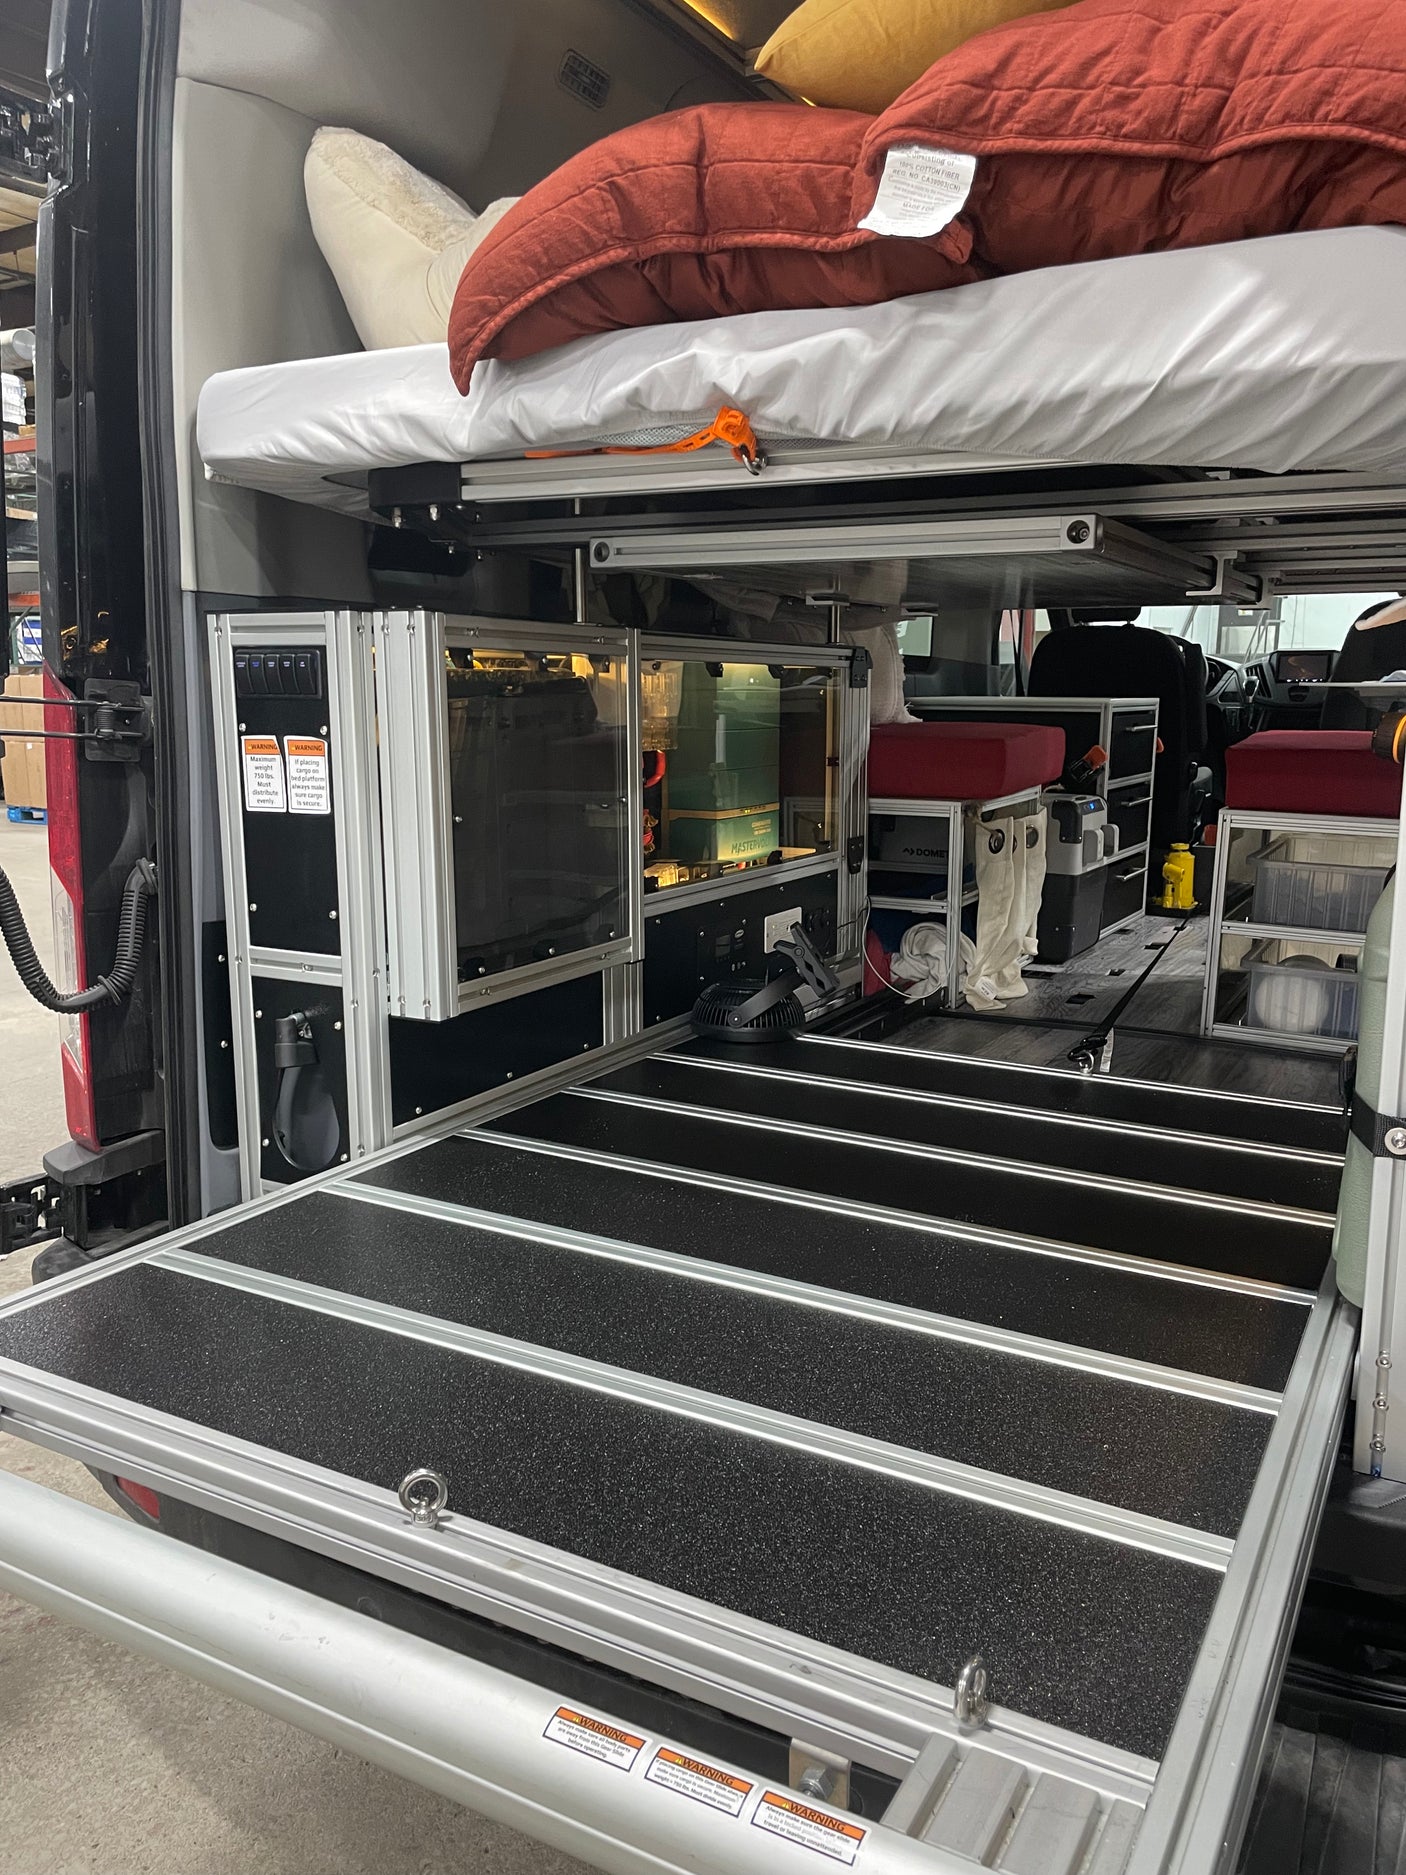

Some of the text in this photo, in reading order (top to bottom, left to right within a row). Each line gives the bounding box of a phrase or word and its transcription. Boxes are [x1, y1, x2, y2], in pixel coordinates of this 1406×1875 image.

[915, 165, 939, 175] COTTON
[941, 170, 959, 180] FIBER
[916, 848, 948, 858] DOMET
[557, 1719, 574, 1730] Always
[580, 1717, 626, 1742] WARNING
[568, 1738, 582, 1747] before
[683, 1758, 733, 1785] WARNING
[765, 1806, 784, 1817] Always
[786, 1814, 799, 1822] make
[791, 1803, 844, 1831] WARNING
[764, 1819, 778, 1829] travel
[786, 1828, 805, 1841] leaving
